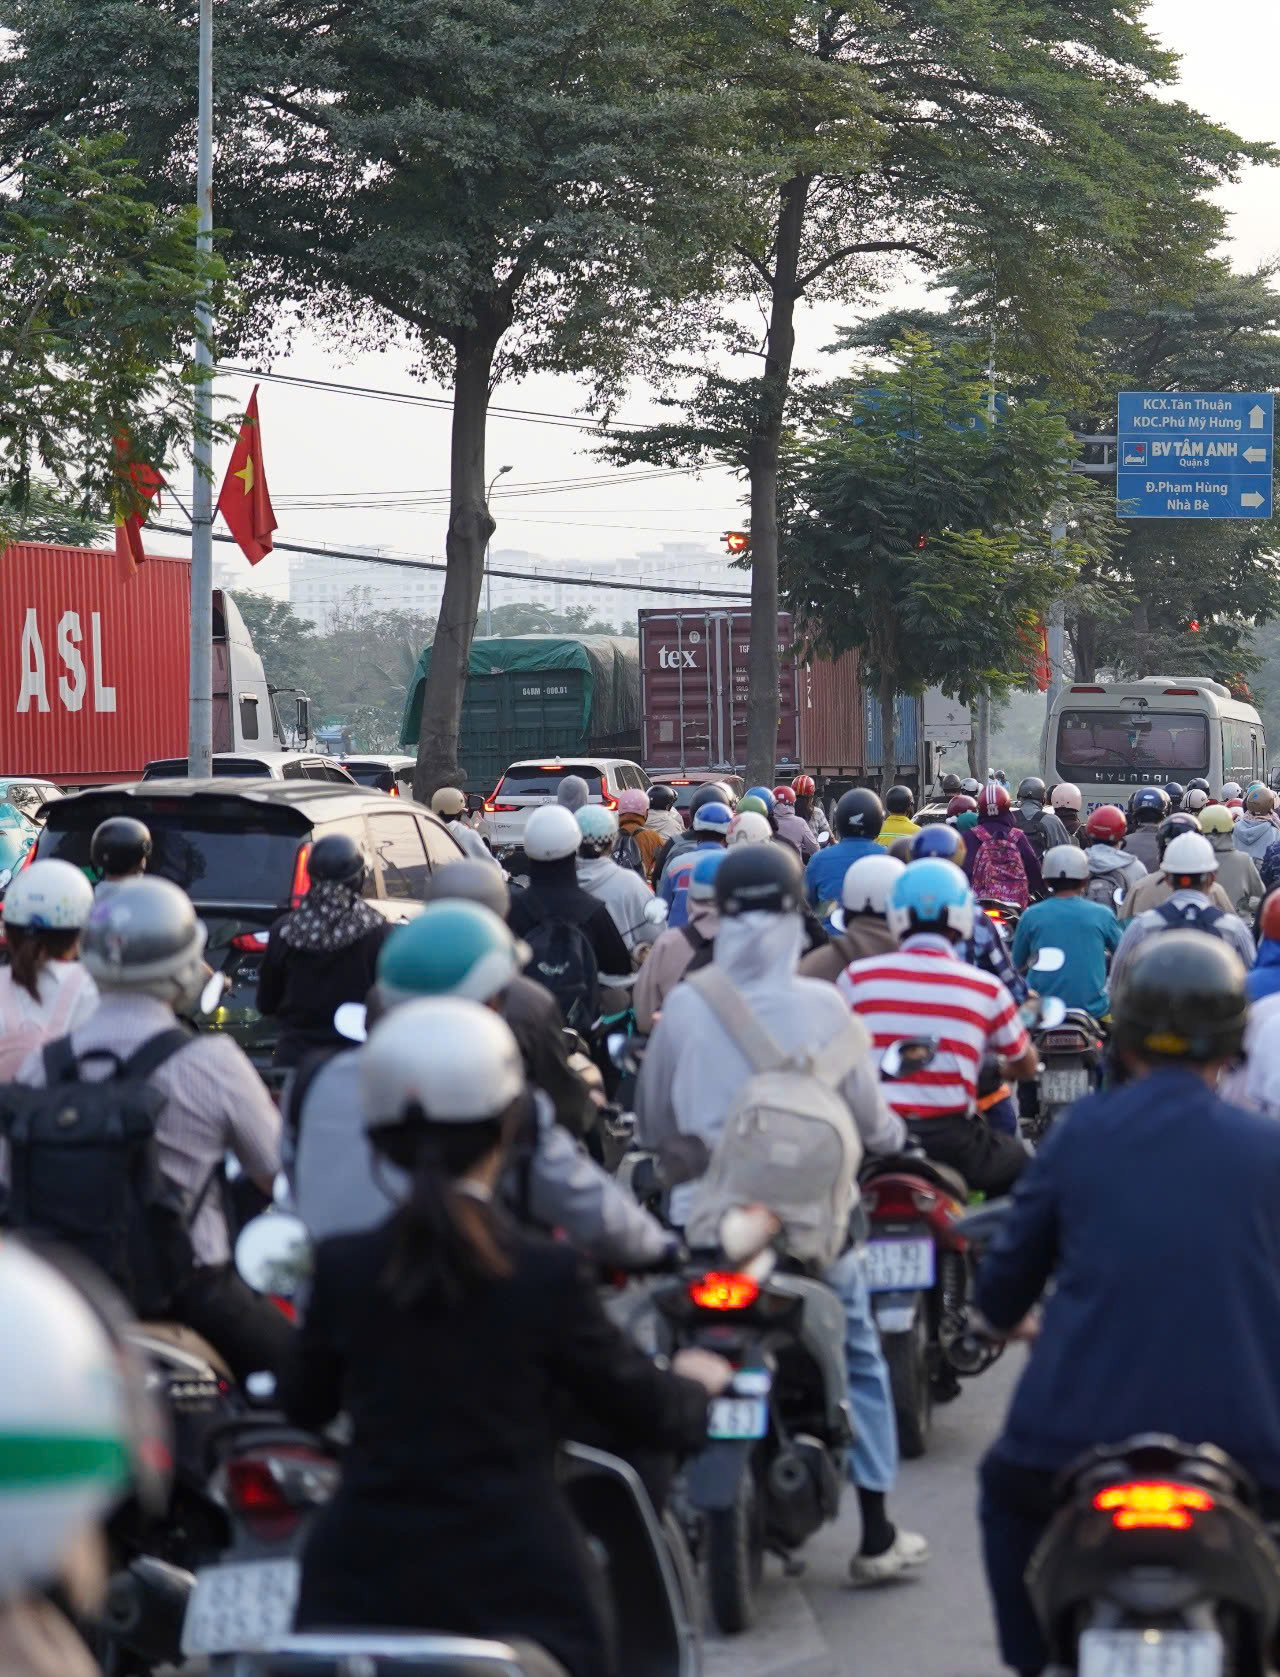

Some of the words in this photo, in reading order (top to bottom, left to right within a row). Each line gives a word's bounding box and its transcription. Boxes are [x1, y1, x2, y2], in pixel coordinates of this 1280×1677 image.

[1143, 399, 1192, 410] KCX.Tân
[1194, 399, 1232, 413] Thuận
[1133, 416, 1185, 428] KDC.Phú
[1188, 416, 1207, 430] Mỹ
[1209, 416, 1242, 430] Hưng
[1151, 442, 1171, 457] BV
[1173, 439, 1204, 457] TÂM
[1206, 442, 1238, 457] ANH
[1179, 458, 1202, 468] Quận
[1203, 459, 1210, 467] 8
[1145, 482, 1193, 495] Đ.Phạm
[1195, 482, 1228, 495] Hùng
[1167, 499, 1191, 511] Nhà
[1194, 499, 1209, 511] Bè
[16, 607, 118, 713] ASL
[658, 644, 698, 669] tex
[1095, 772, 1169, 783] HYUNDAI
